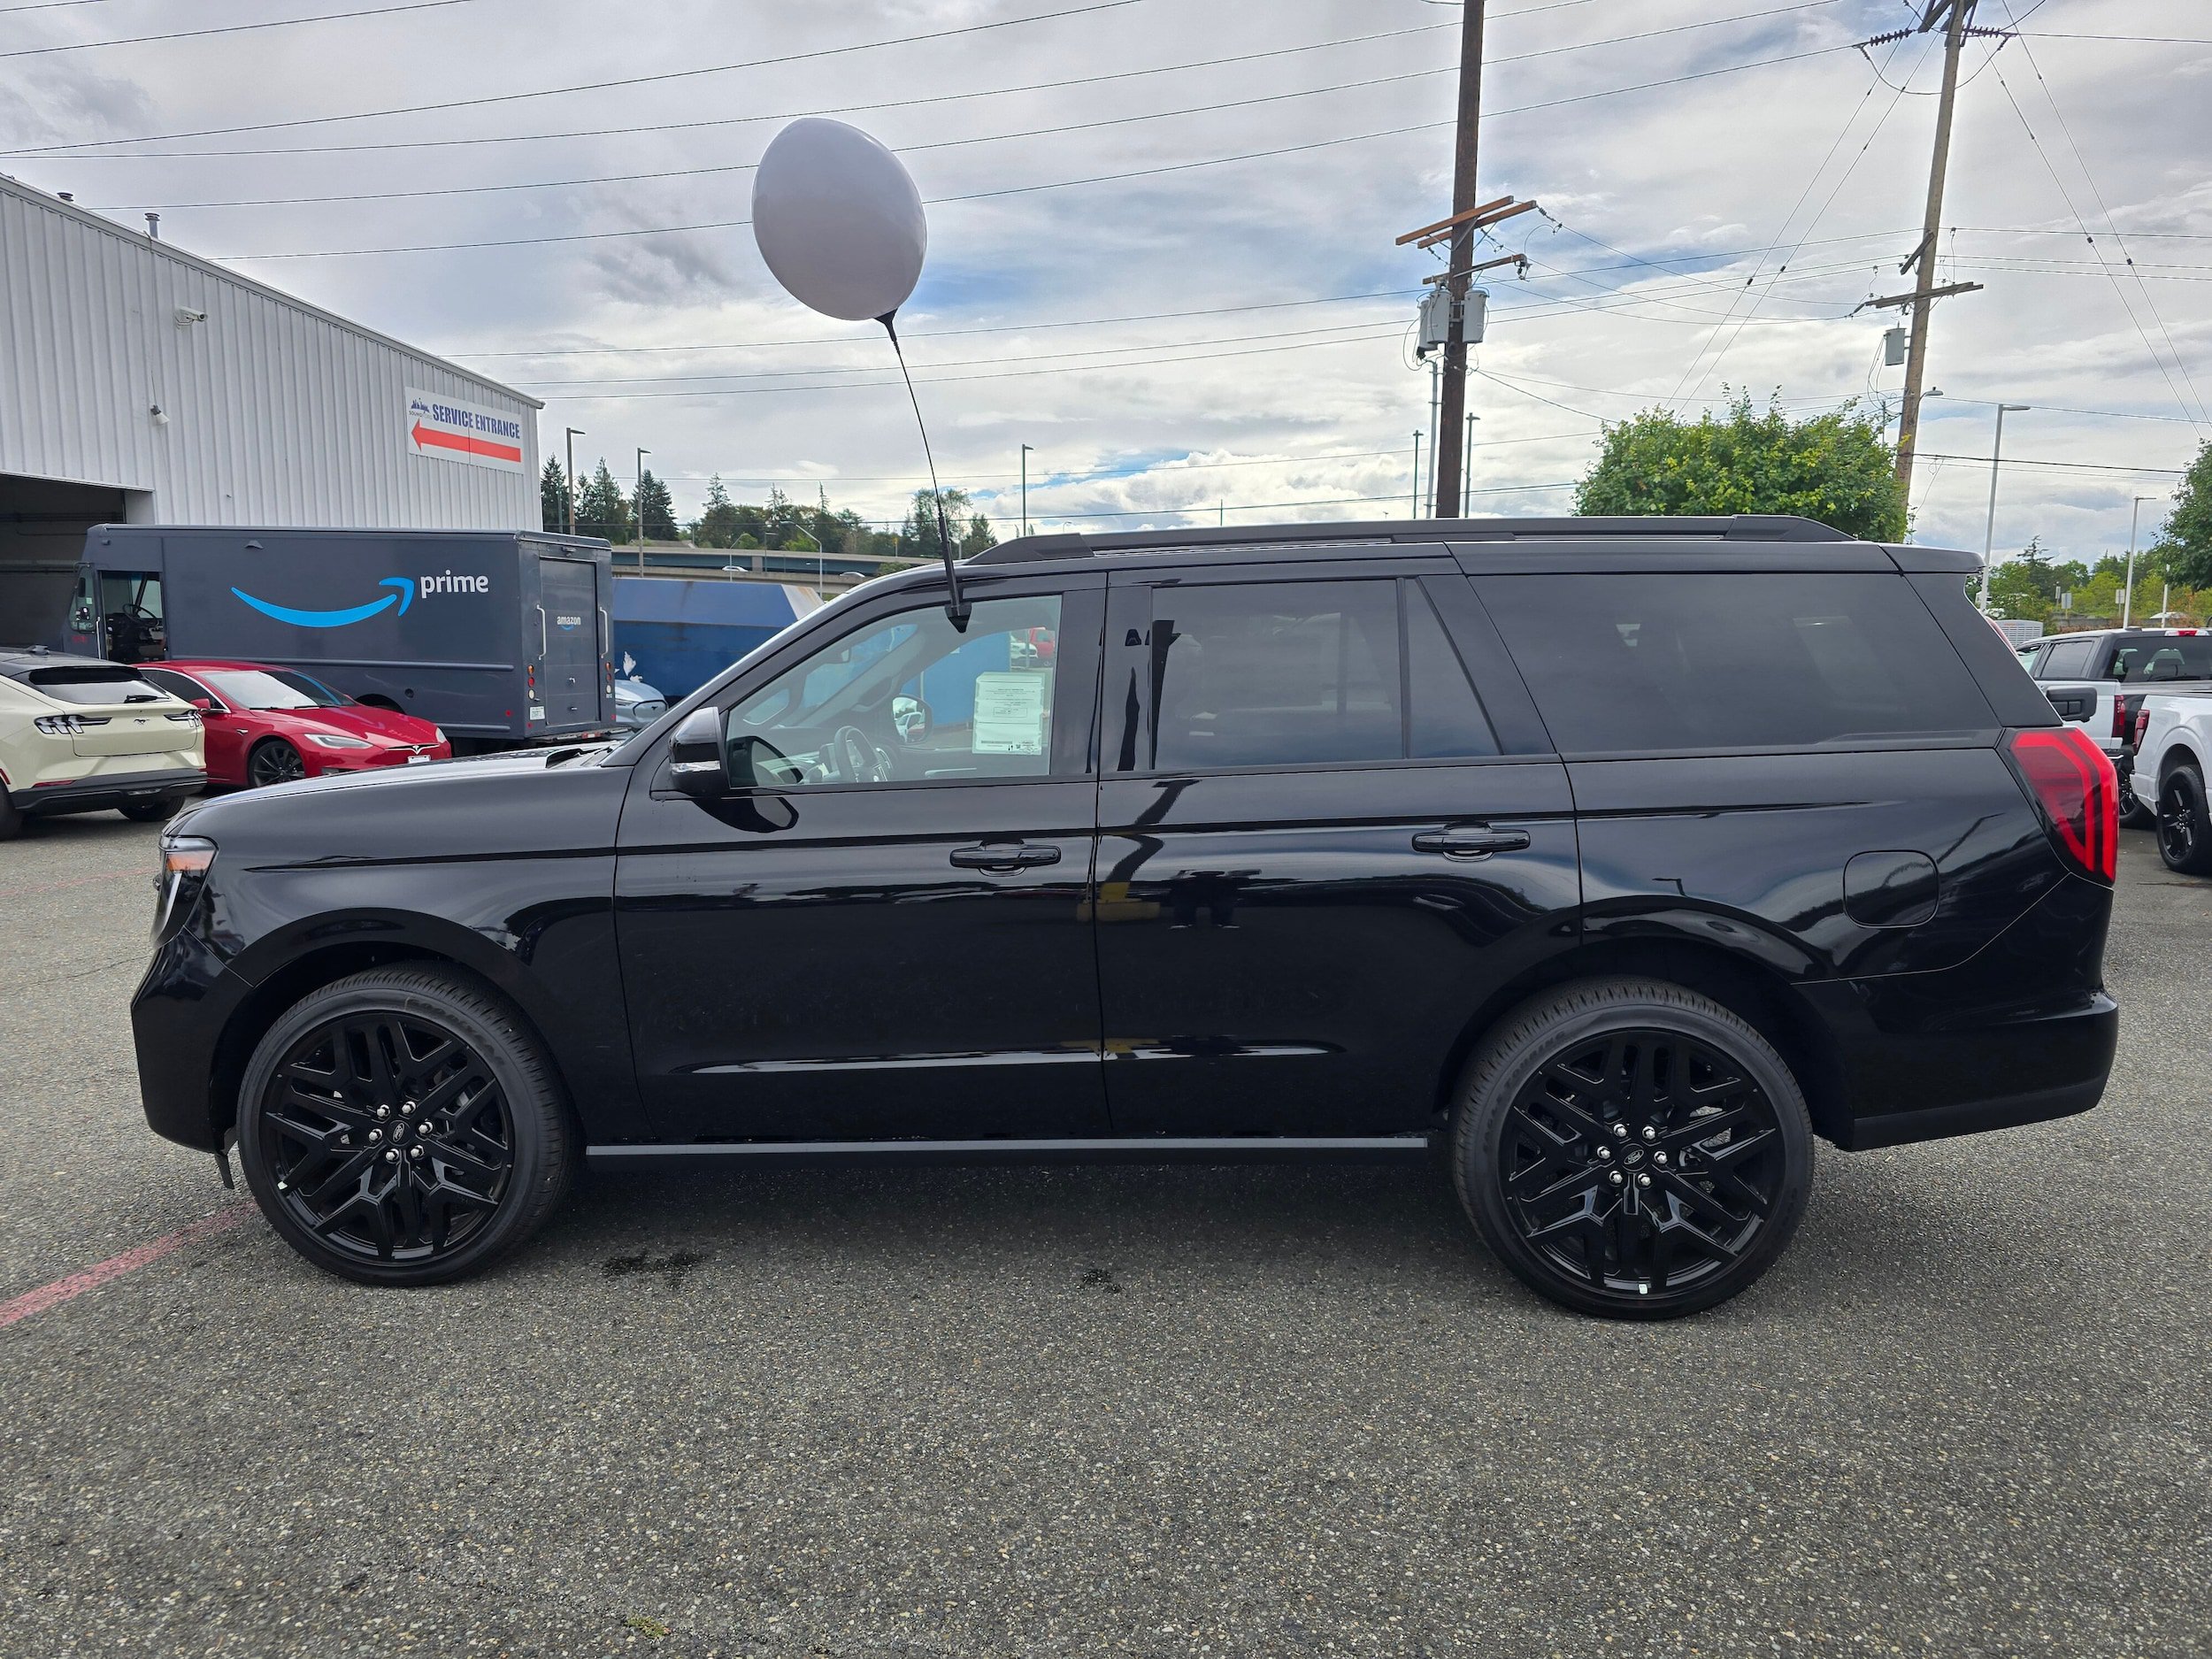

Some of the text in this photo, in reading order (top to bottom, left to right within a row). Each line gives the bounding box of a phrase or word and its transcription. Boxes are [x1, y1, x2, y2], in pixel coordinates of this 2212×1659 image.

[433, 403, 520, 440] SERVICE ENTRANCE
[420, 569, 489, 599] prime
[557, 616, 581, 626] amazon
